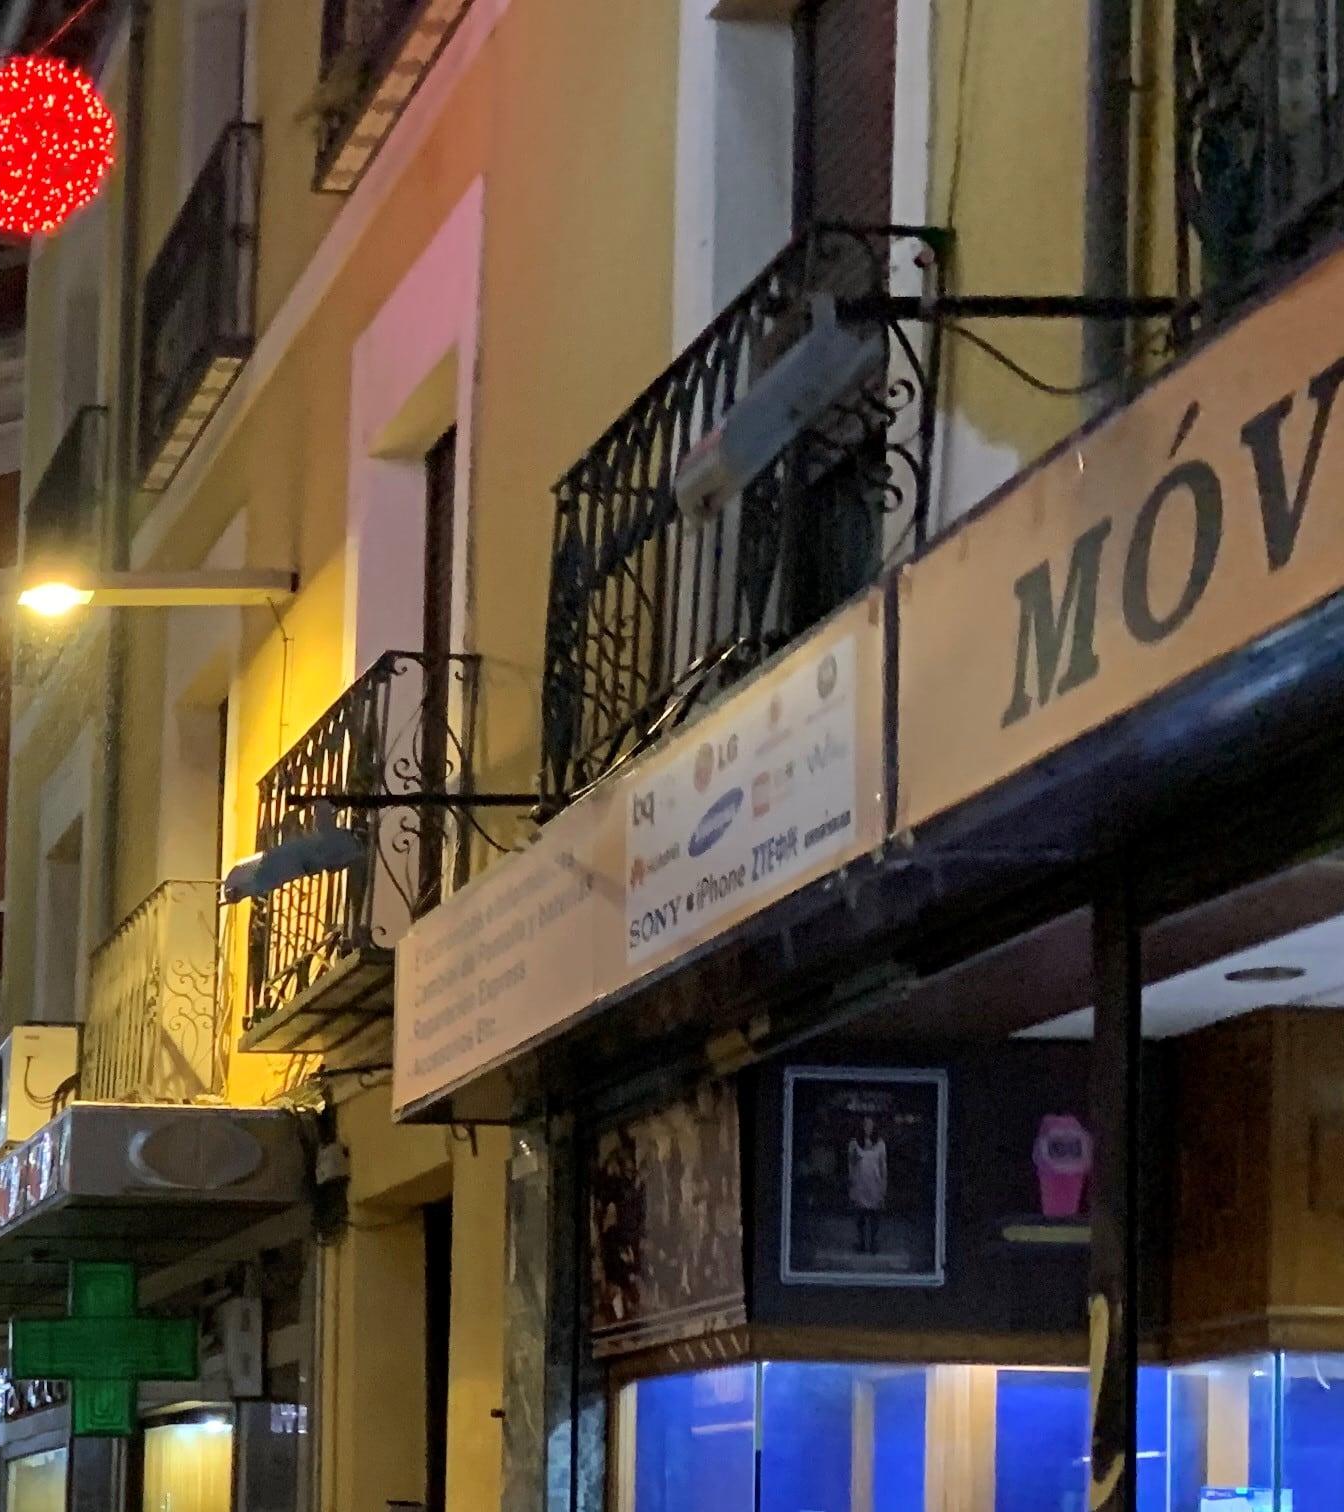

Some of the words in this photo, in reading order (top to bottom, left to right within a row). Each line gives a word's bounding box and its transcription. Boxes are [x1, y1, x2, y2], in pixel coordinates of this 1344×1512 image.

[1000, 355, 1344, 730] MÓV
[718, 732, 739, 771] LG
[696, 863, 746, 912] iPhone
[629, 894, 682, 949] SONY
